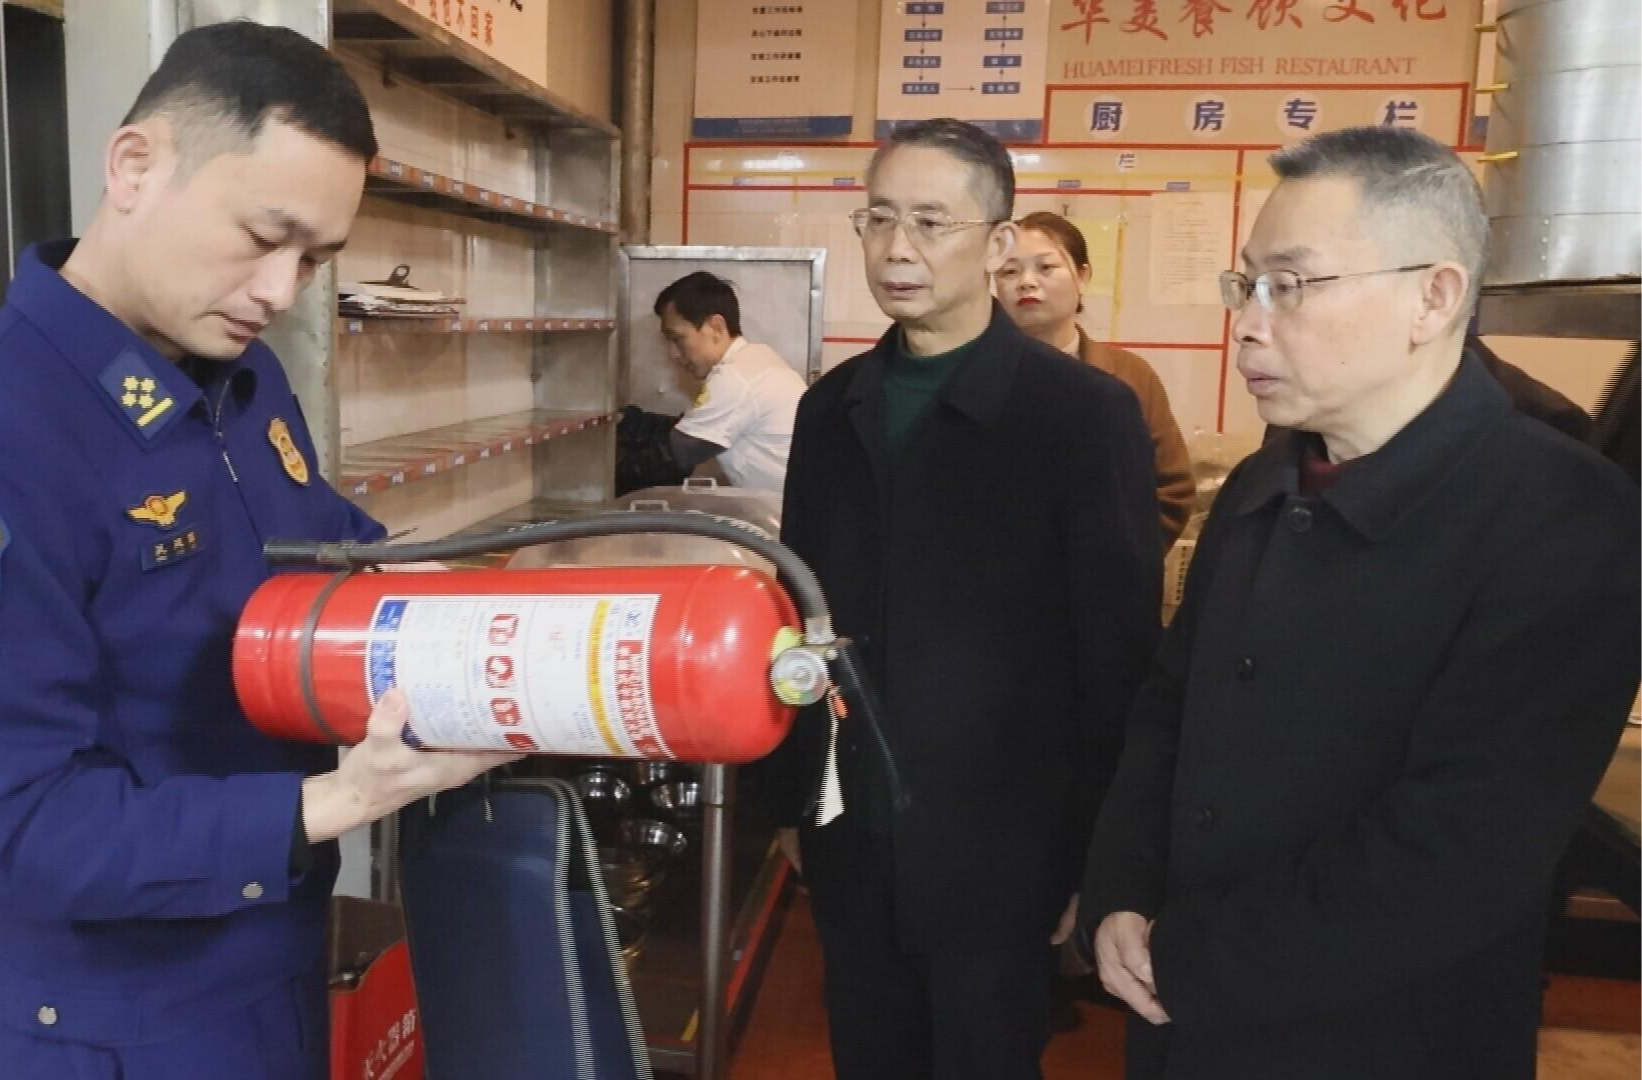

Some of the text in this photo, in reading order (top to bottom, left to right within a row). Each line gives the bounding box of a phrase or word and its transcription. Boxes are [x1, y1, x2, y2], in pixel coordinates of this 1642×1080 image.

[1220, 56, 1265, 75] FISH
[1274, 56, 1418, 76] RESTAURANT
[1090, 98, 1419, 132] 厨房专栏
